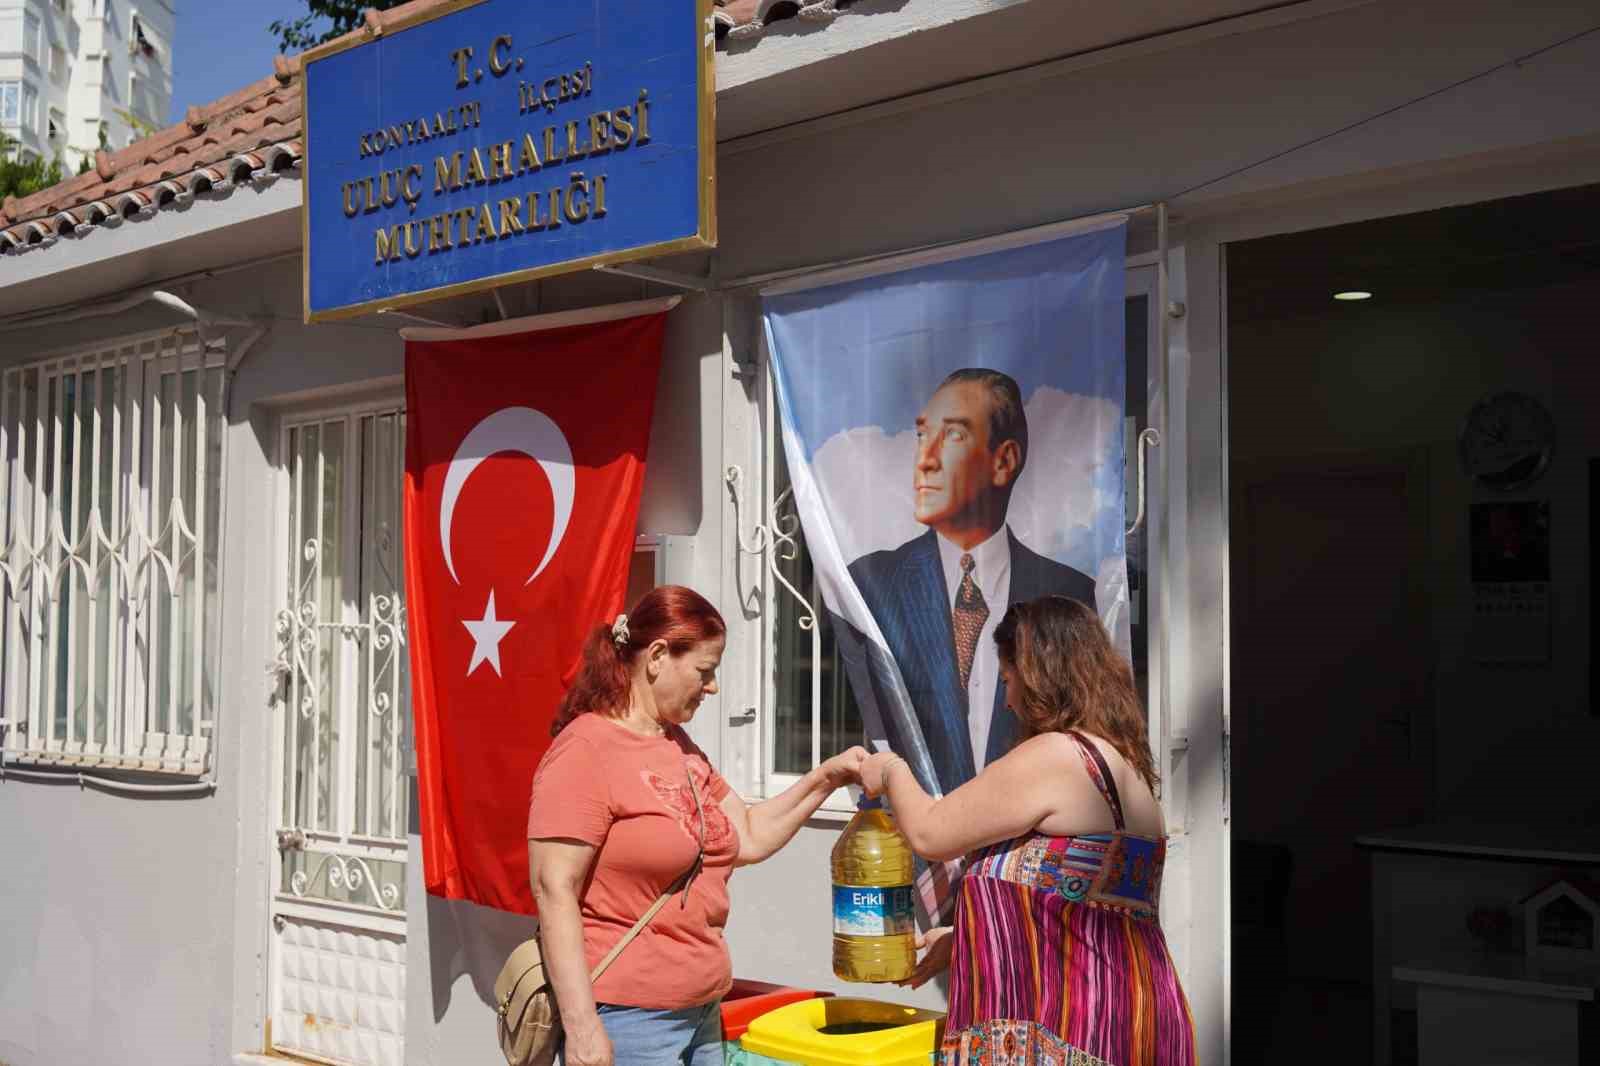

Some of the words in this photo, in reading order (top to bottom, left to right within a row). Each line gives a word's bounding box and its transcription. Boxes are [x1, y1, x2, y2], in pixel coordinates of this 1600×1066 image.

[342, 165, 423, 218] ULUÇ
[433, 89, 652, 196] MAHALLESİ
[360, 101, 482, 159] KONYAALTI
[519, 61, 593, 115] İLÇESİ
[374, 172, 608, 264] MUHTARLIĞI
